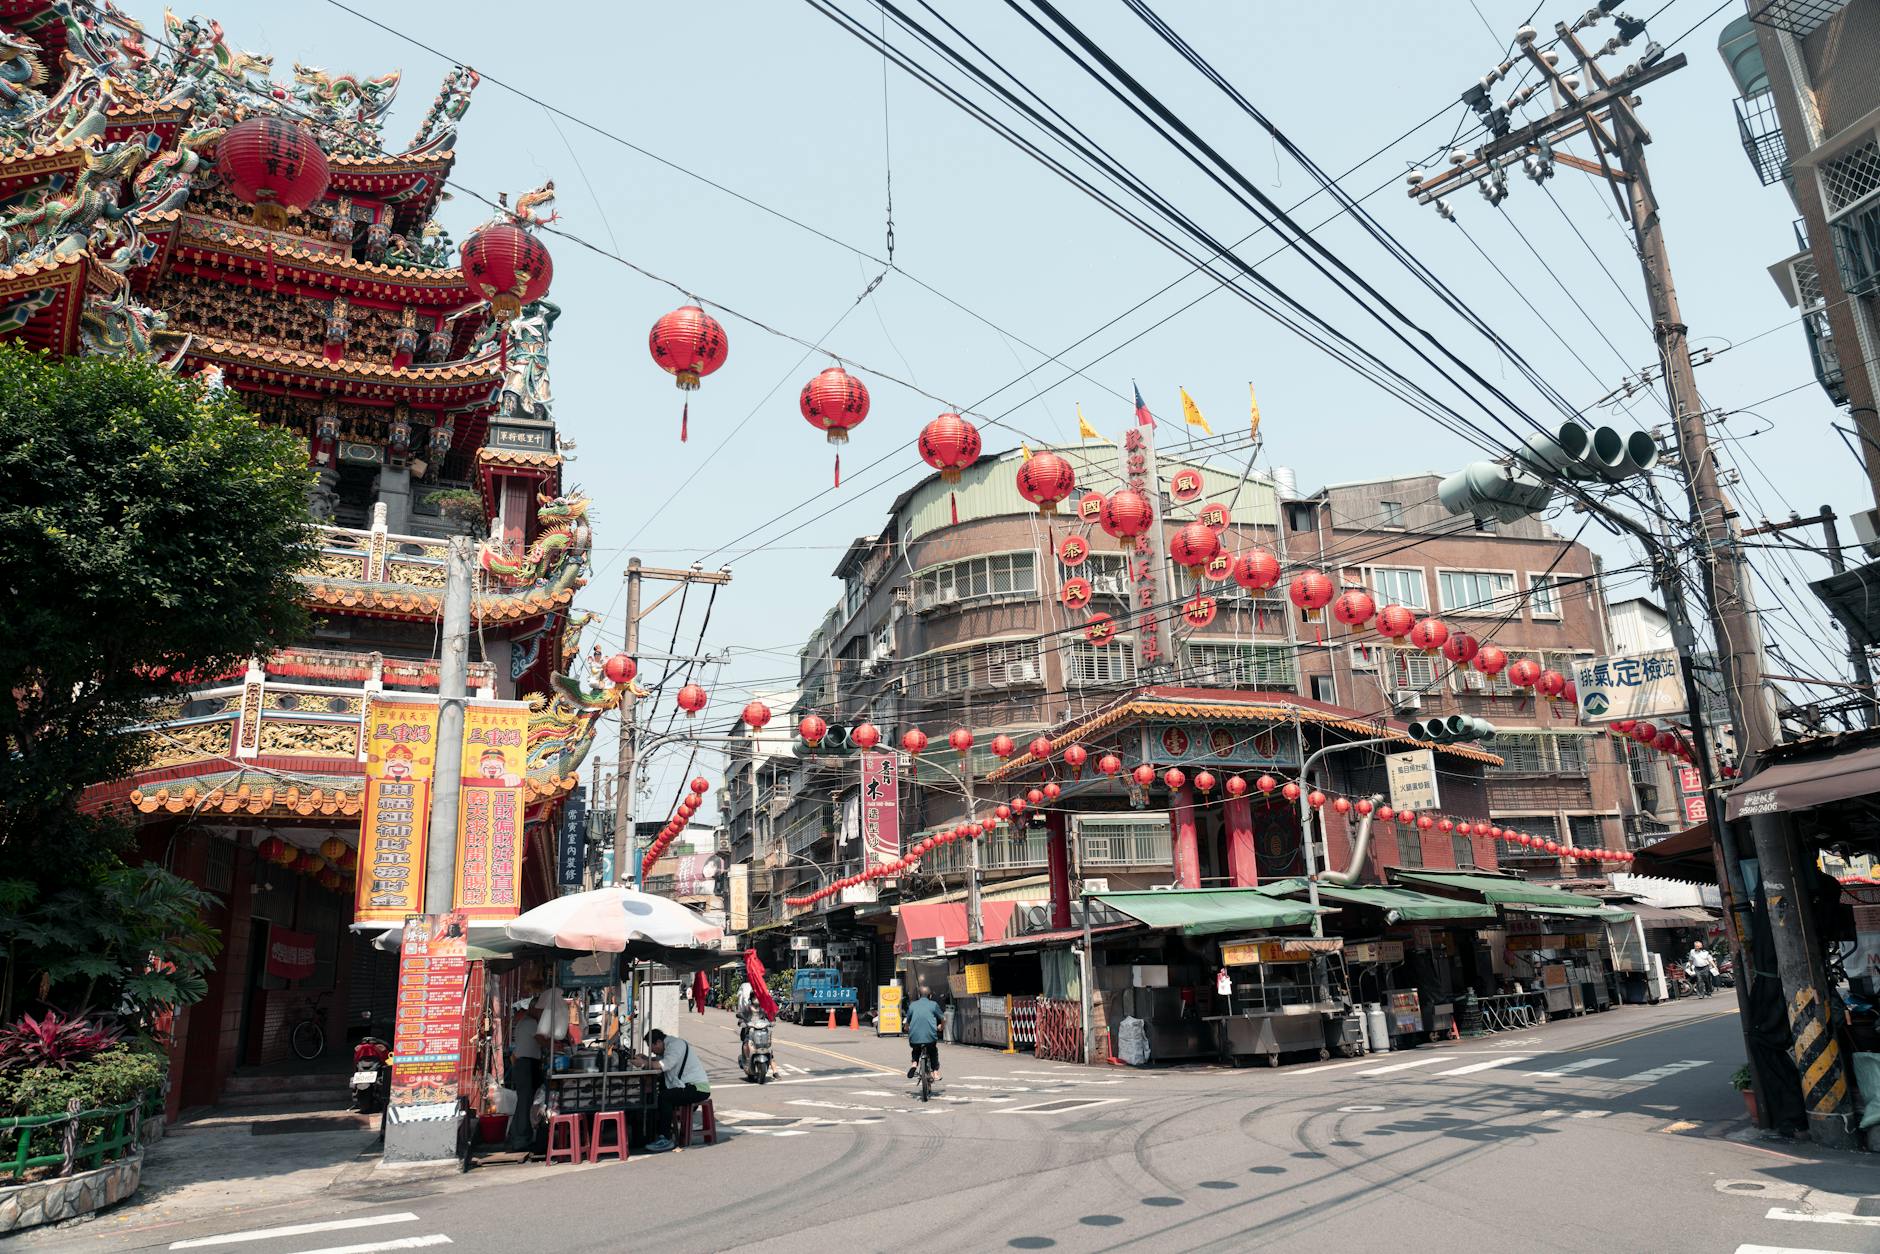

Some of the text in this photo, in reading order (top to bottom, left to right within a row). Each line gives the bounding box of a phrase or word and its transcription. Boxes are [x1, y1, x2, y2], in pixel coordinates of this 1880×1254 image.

[1124, 428, 1163, 664] 歡迎蒞義天宮指導
[1580, 657, 1676, 687] 排氣定檢站
[373, 723, 431, 744] 三重媽
[467, 727, 523, 747] 三重媽
[464, 790, 489, 904] 義天求財開運賜財
[492, 791, 515, 904] 正財偏財好運直來
[868, 807, 880, 863] 造型沙龍
